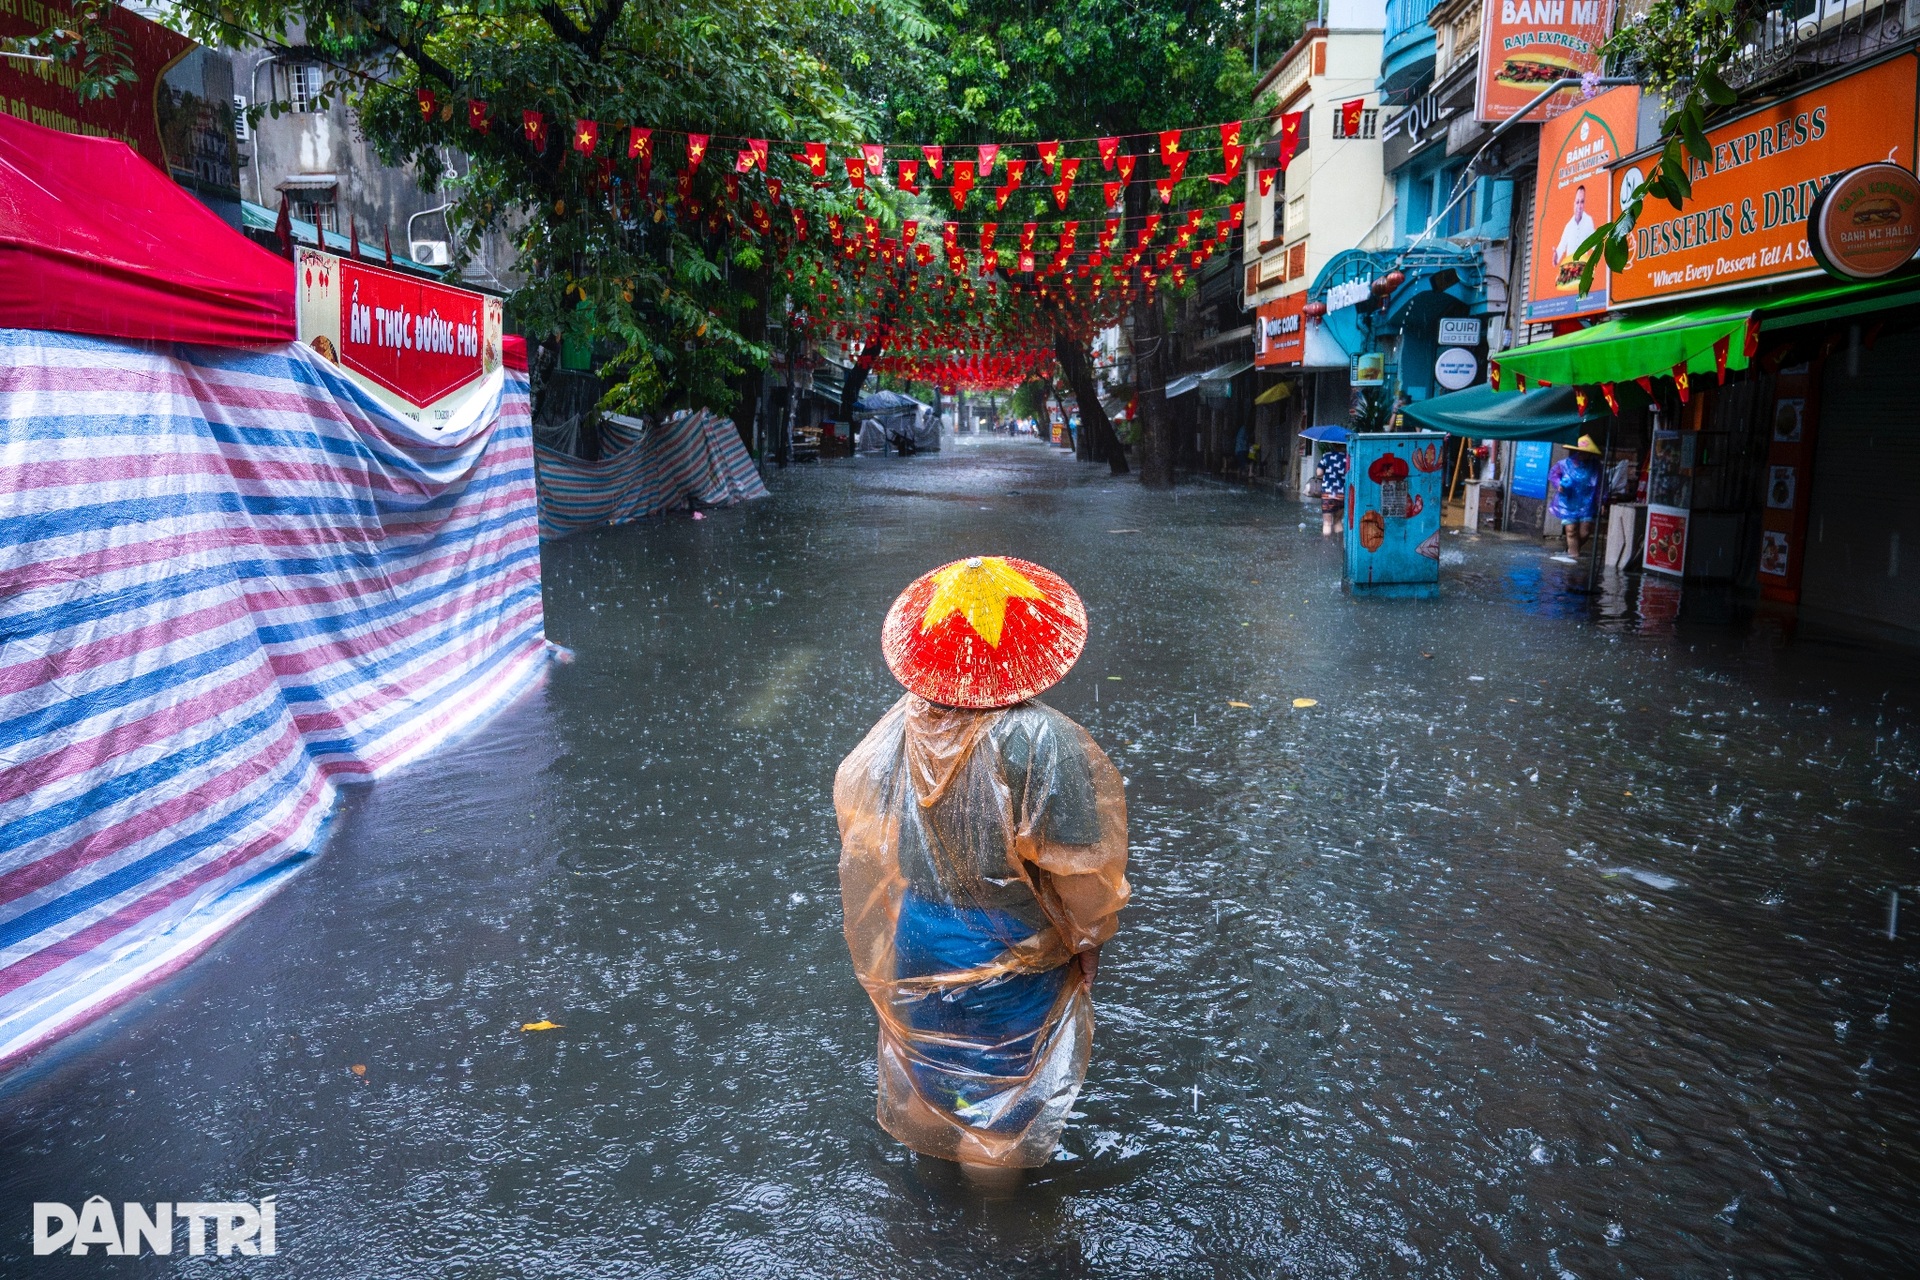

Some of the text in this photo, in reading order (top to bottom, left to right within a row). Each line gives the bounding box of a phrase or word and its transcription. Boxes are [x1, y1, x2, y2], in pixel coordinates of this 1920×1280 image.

[1503, 31, 1590, 55] RAJA EXPRESS
[1713, 105, 1827, 175] EXPRESS
[1566, 143, 1591, 165] BÁNH
[1636, 168, 1846, 261] DESSERTS & DRIN
[1840, 224, 1915, 243] BANH MI HALAL
[1685, 263, 1714, 282] Every
[1715, 255, 1757, 276] Dessert
[1759, 246, 1781, 267] Tell
[1782, 242, 1793, 263] A
[350, 278, 478, 358] ẨM THỰC ĐƯỜNG PHỐ
[1282, 314, 1299, 334] COOK
[1445, 321, 1478, 332] QUIRI
